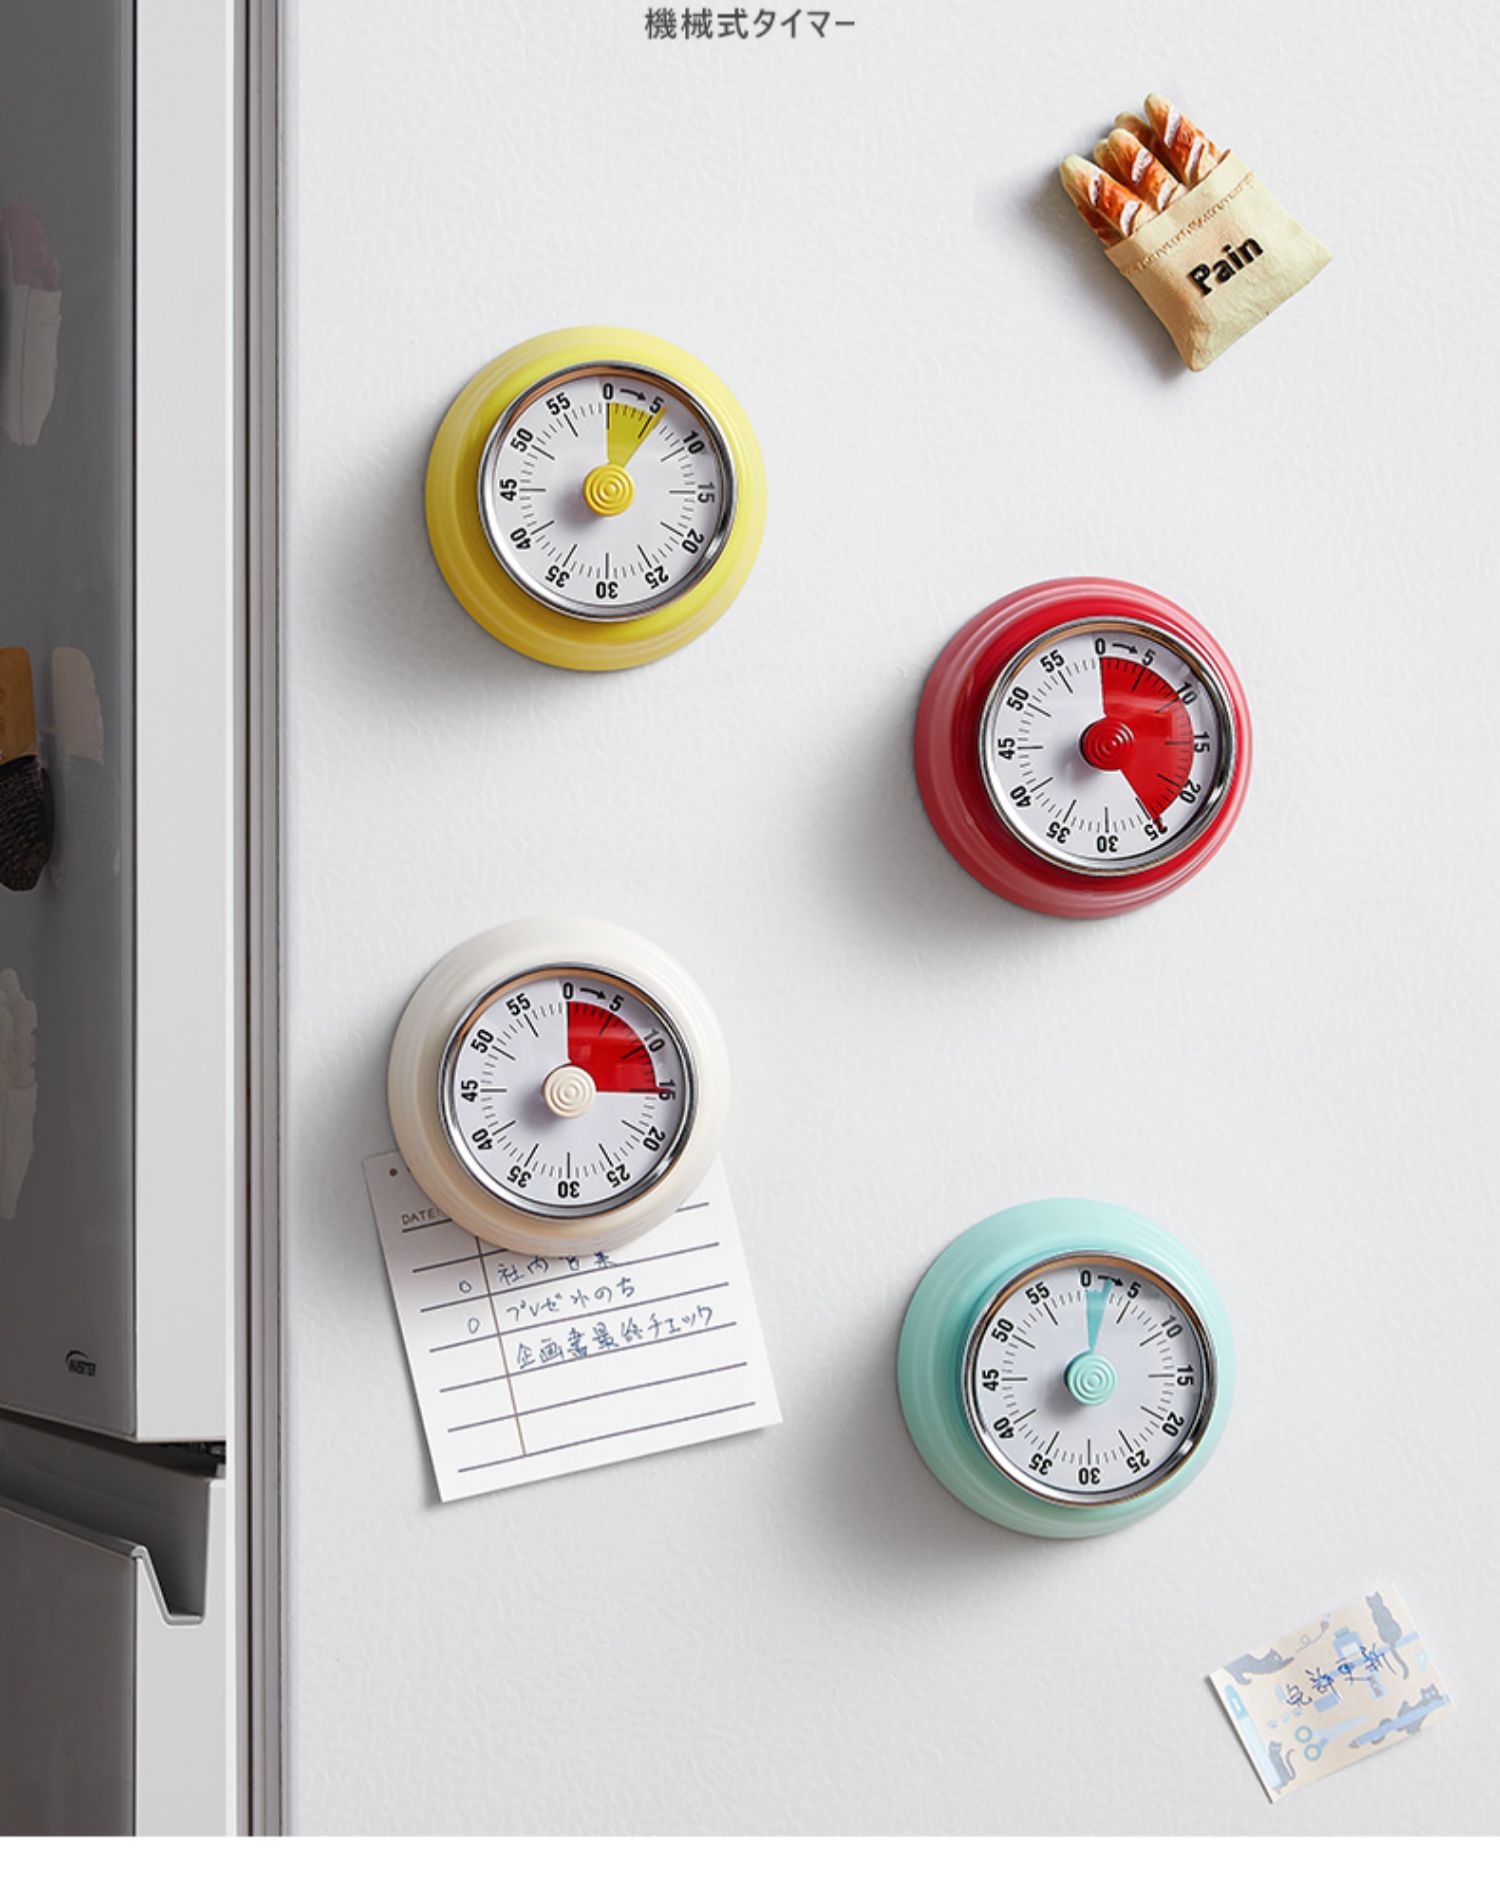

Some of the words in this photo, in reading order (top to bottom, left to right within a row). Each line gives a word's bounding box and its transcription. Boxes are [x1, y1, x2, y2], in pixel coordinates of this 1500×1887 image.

[1187, 238, 1264, 297] Pain
[602, 383, 614, 400] 0
[546, 392, 571, 416] 55
[649, 396, 665, 414] 5
[511, 428, 534, 452] 50
[683, 430, 706, 455] 10
[500, 478, 517, 501] 45
[697, 482, 715, 503] 15
[510, 528, 531, 550] 40
[681, 529, 705, 553] 20
[545, 566, 570, 588] 35
[645, 567, 669, 590] 25
[596, 582, 618, 599] 30
[1095, 638, 1106, 655] 0
[1142, 649, 1156, 666] 5
[1040, 649, 1065, 673] 55
[1006, 687, 1029, 711] 50
[1176, 682, 1197, 705] 10
[998, 738, 1015, 760] 45
[1194, 732, 1210, 752] 15
[1010, 786, 1031, 807] 40
[1180, 780, 1201, 804] 20
[1046, 822, 1070, 844] 35
[1097, 836, 1118, 853] 30
[562, 982, 574, 1000] 0
[506, 993, 531, 1017] 55
[609, 995, 624, 1012] 5
[471, 1029, 494, 1054] 50
[643, 1028, 665, 1052] 10
[461, 1079, 478, 1102] 45
[472, 1128, 493, 1151] 40
[643, 1125, 666, 1152] 20
[507, 1166, 532, 1188] 35
[607, 1164, 630, 1188] 25
[558, 1181, 580, 1198] 30
[1080, 1270, 1091, 1287] 0
[1128, 1281, 1142, 1299] 5
[1025, 1282, 1050, 1305] 55
[991, 1318, 1015, 1343] 50
[1161, 1315, 1183, 1338] 10
[982, 1368, 999, 1391] 45
[1177, 1364, 1194, 1386] 15
[993, 1417, 1014, 1440] 40
[1162, 1412, 1185, 1437] 20
[1029, 1453, 1052, 1475] 35
[1126, 1451, 1149, 1474] 25
[1078, 1468, 1100, 1485] 30
